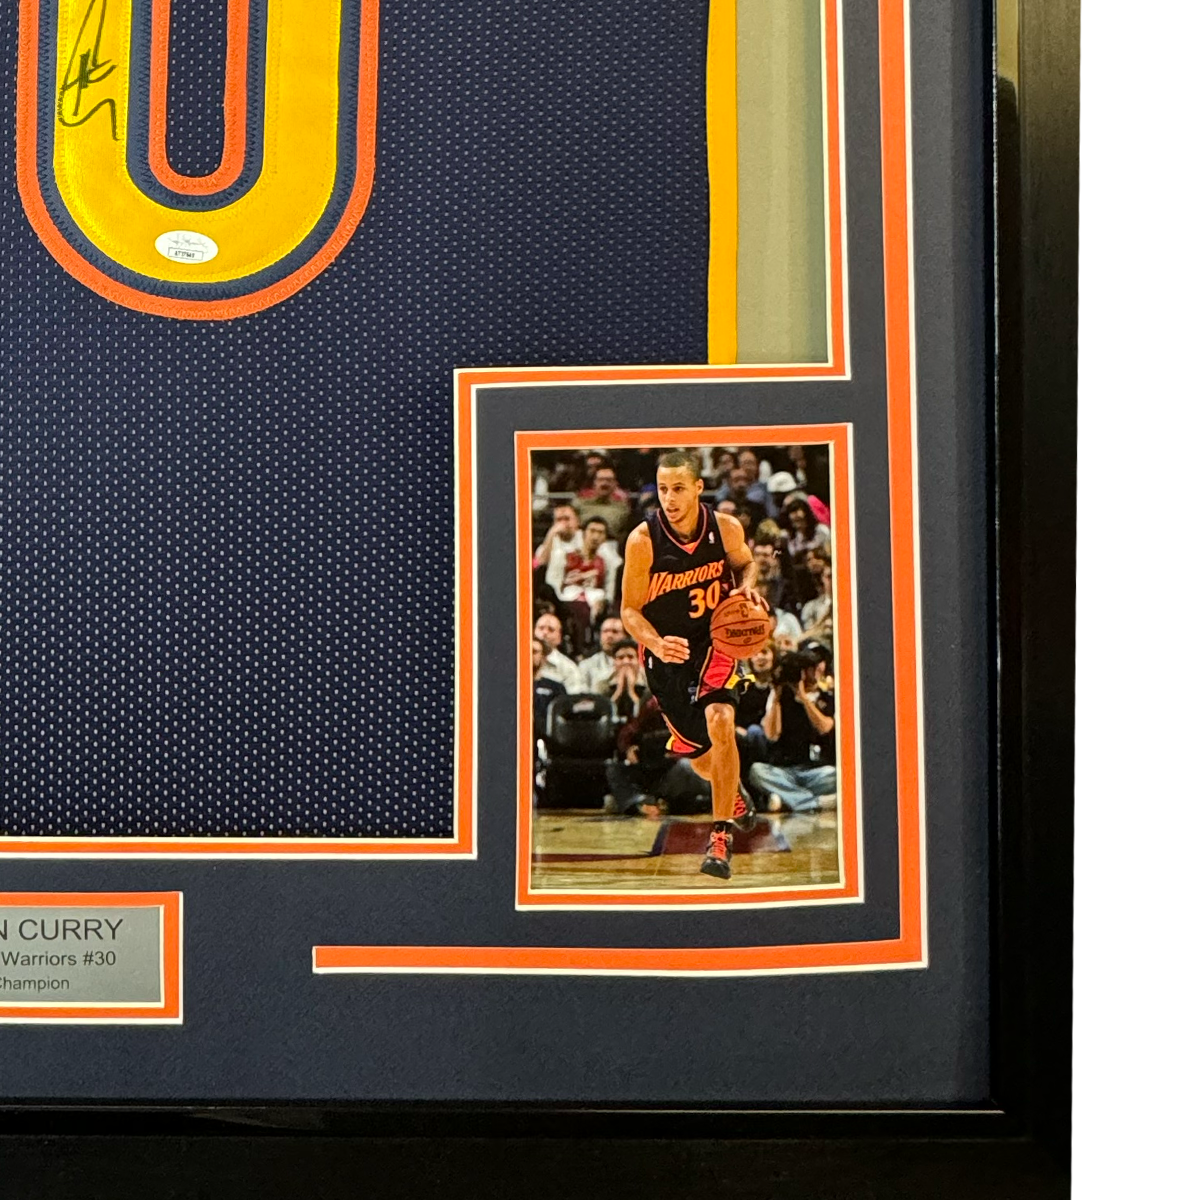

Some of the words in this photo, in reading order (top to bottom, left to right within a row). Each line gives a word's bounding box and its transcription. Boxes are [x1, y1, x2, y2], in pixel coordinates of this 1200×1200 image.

[648, 559, 725, 602] WARRIORS
[688, 580, 720, 619] 30
[17, 918, 124, 941] CURRY
[1, 950, 78, 967] Warriors
[82, 950, 117, 967] #30
